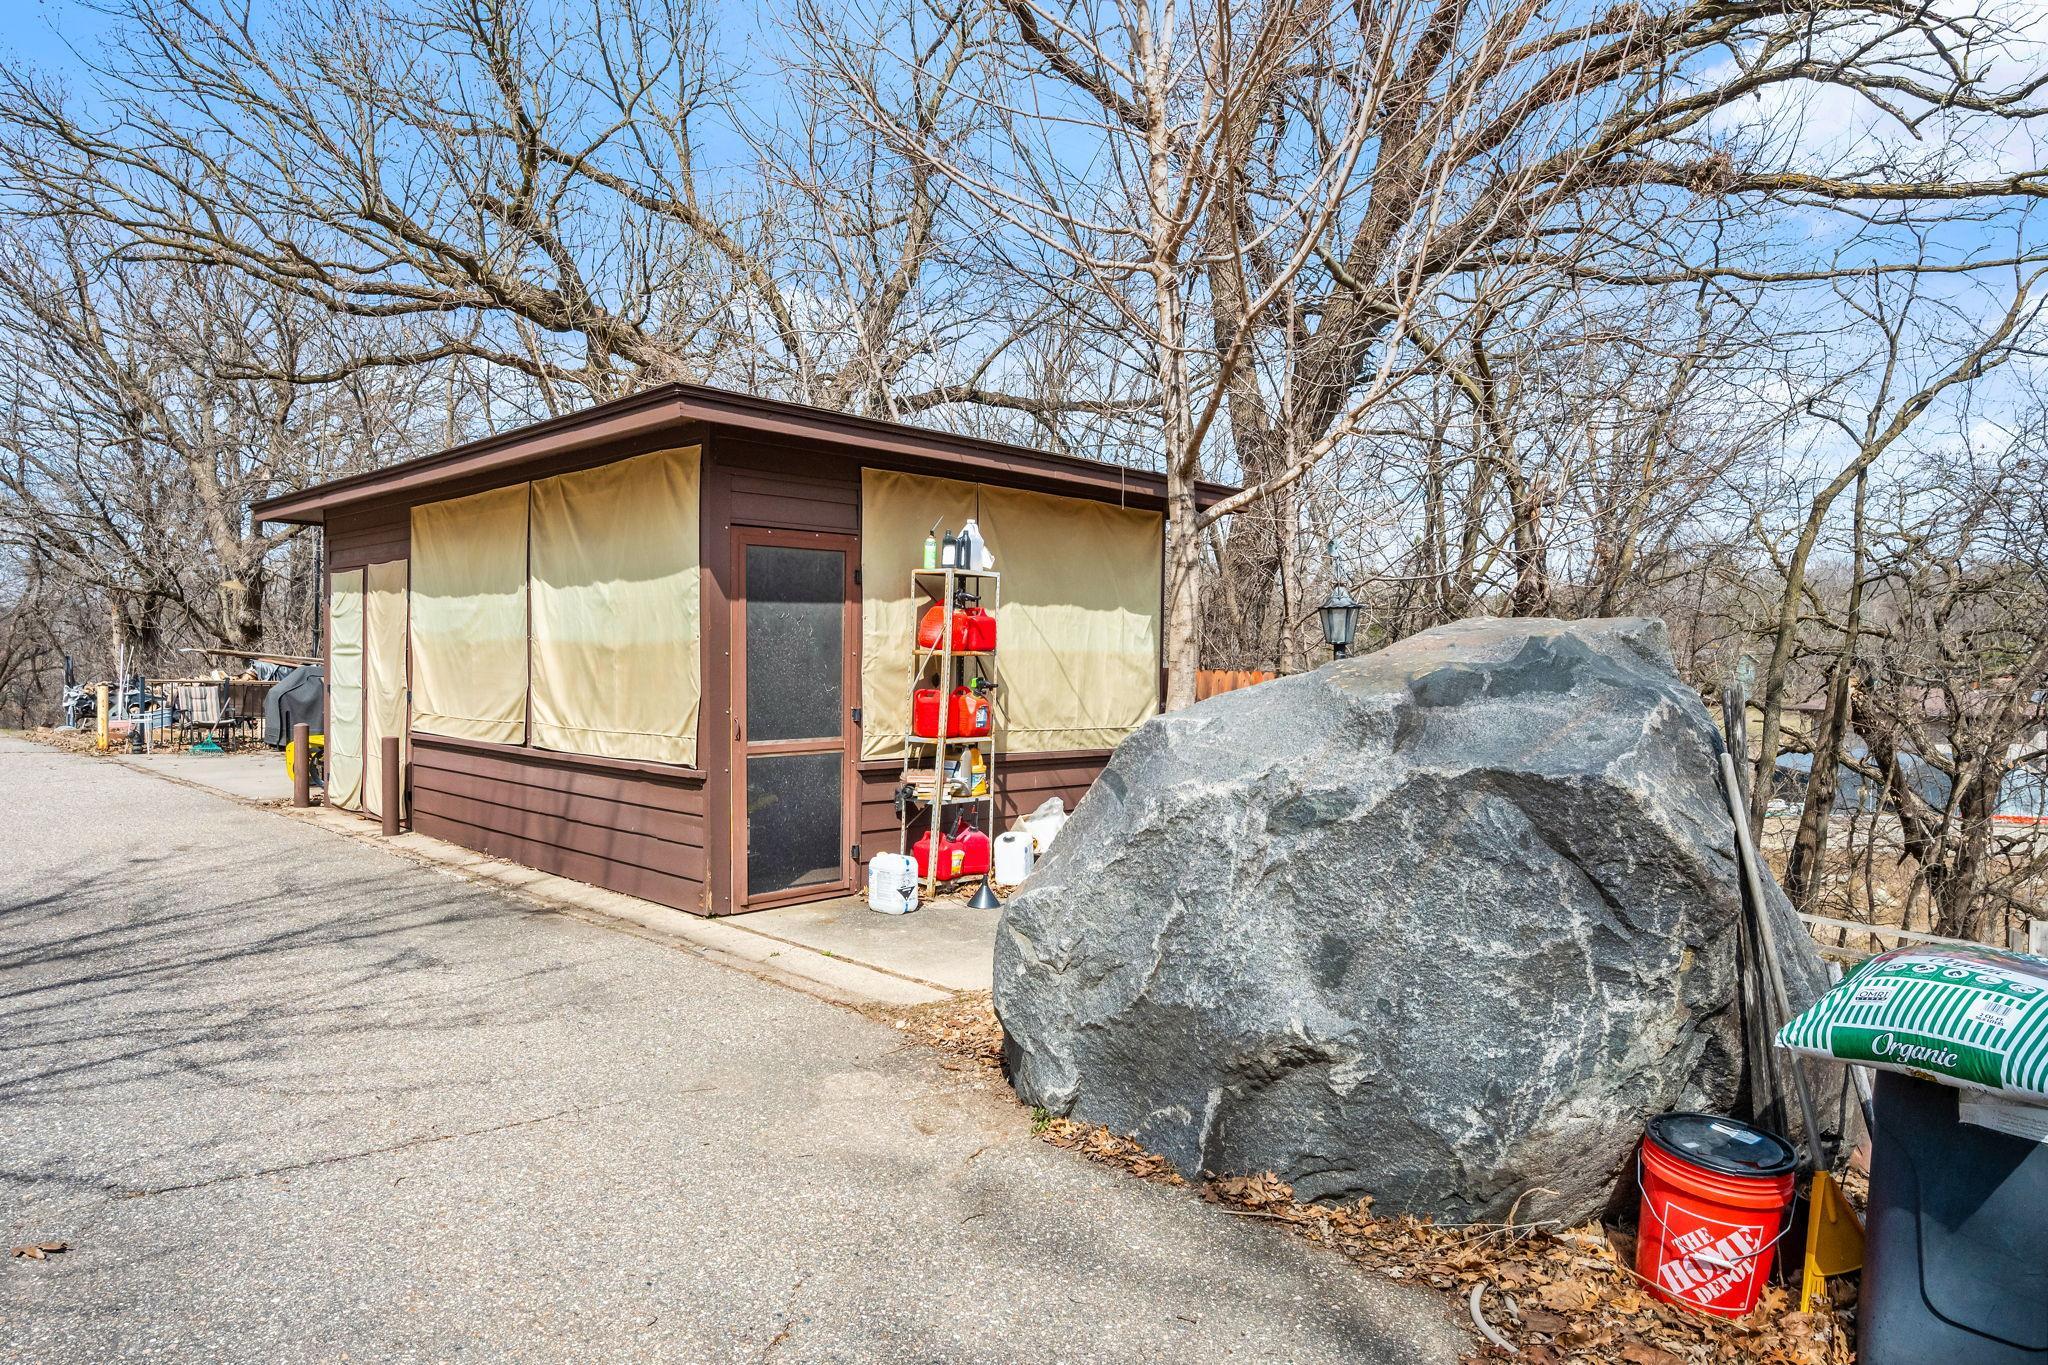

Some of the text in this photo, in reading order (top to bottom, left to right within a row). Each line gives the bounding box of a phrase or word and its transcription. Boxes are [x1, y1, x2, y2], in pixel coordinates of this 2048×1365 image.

[1859, 990, 1889, 998] OMRI
[1872, 1032, 1958, 1068] Organic
[1671, 1227, 1715, 1254] THE
[1660, 1226, 1760, 1294] HOME
[1693, 1257, 1754, 1304] DEPOT
